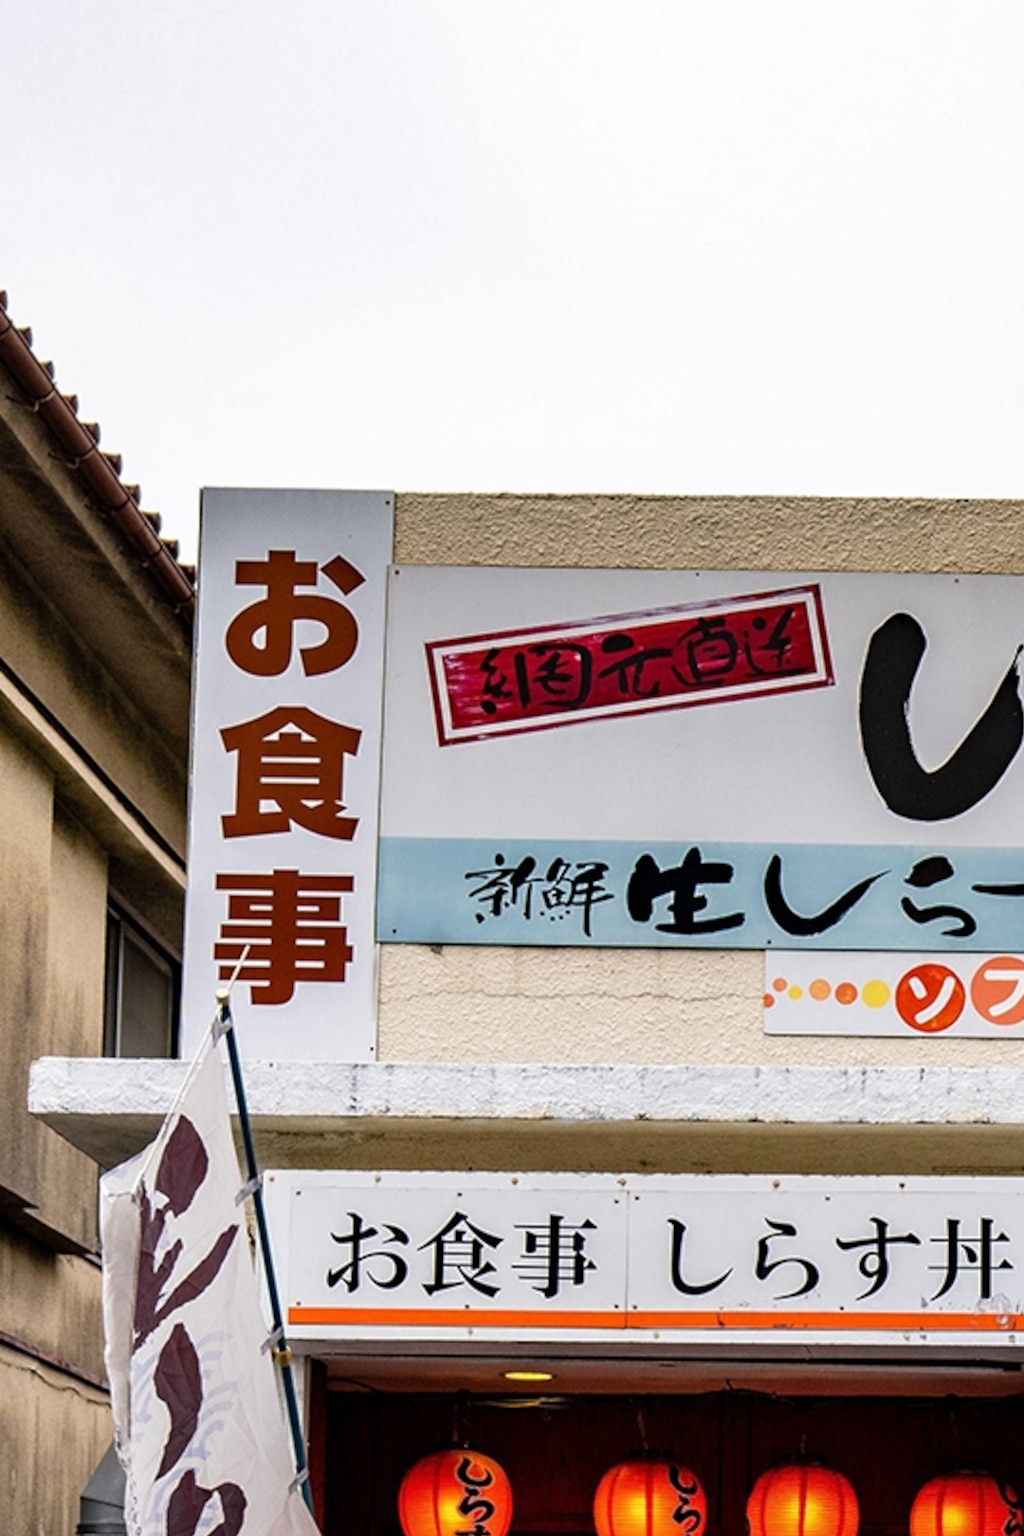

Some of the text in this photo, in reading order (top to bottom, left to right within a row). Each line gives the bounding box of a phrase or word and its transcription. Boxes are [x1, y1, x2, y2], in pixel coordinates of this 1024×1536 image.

[480, 612, 798, 714] 網元直送
[212, 549, 366, 1005] お食事
[327, 1209, 599, 1298] お食事
[667, 1216, 1014, 1301] しらす丼
